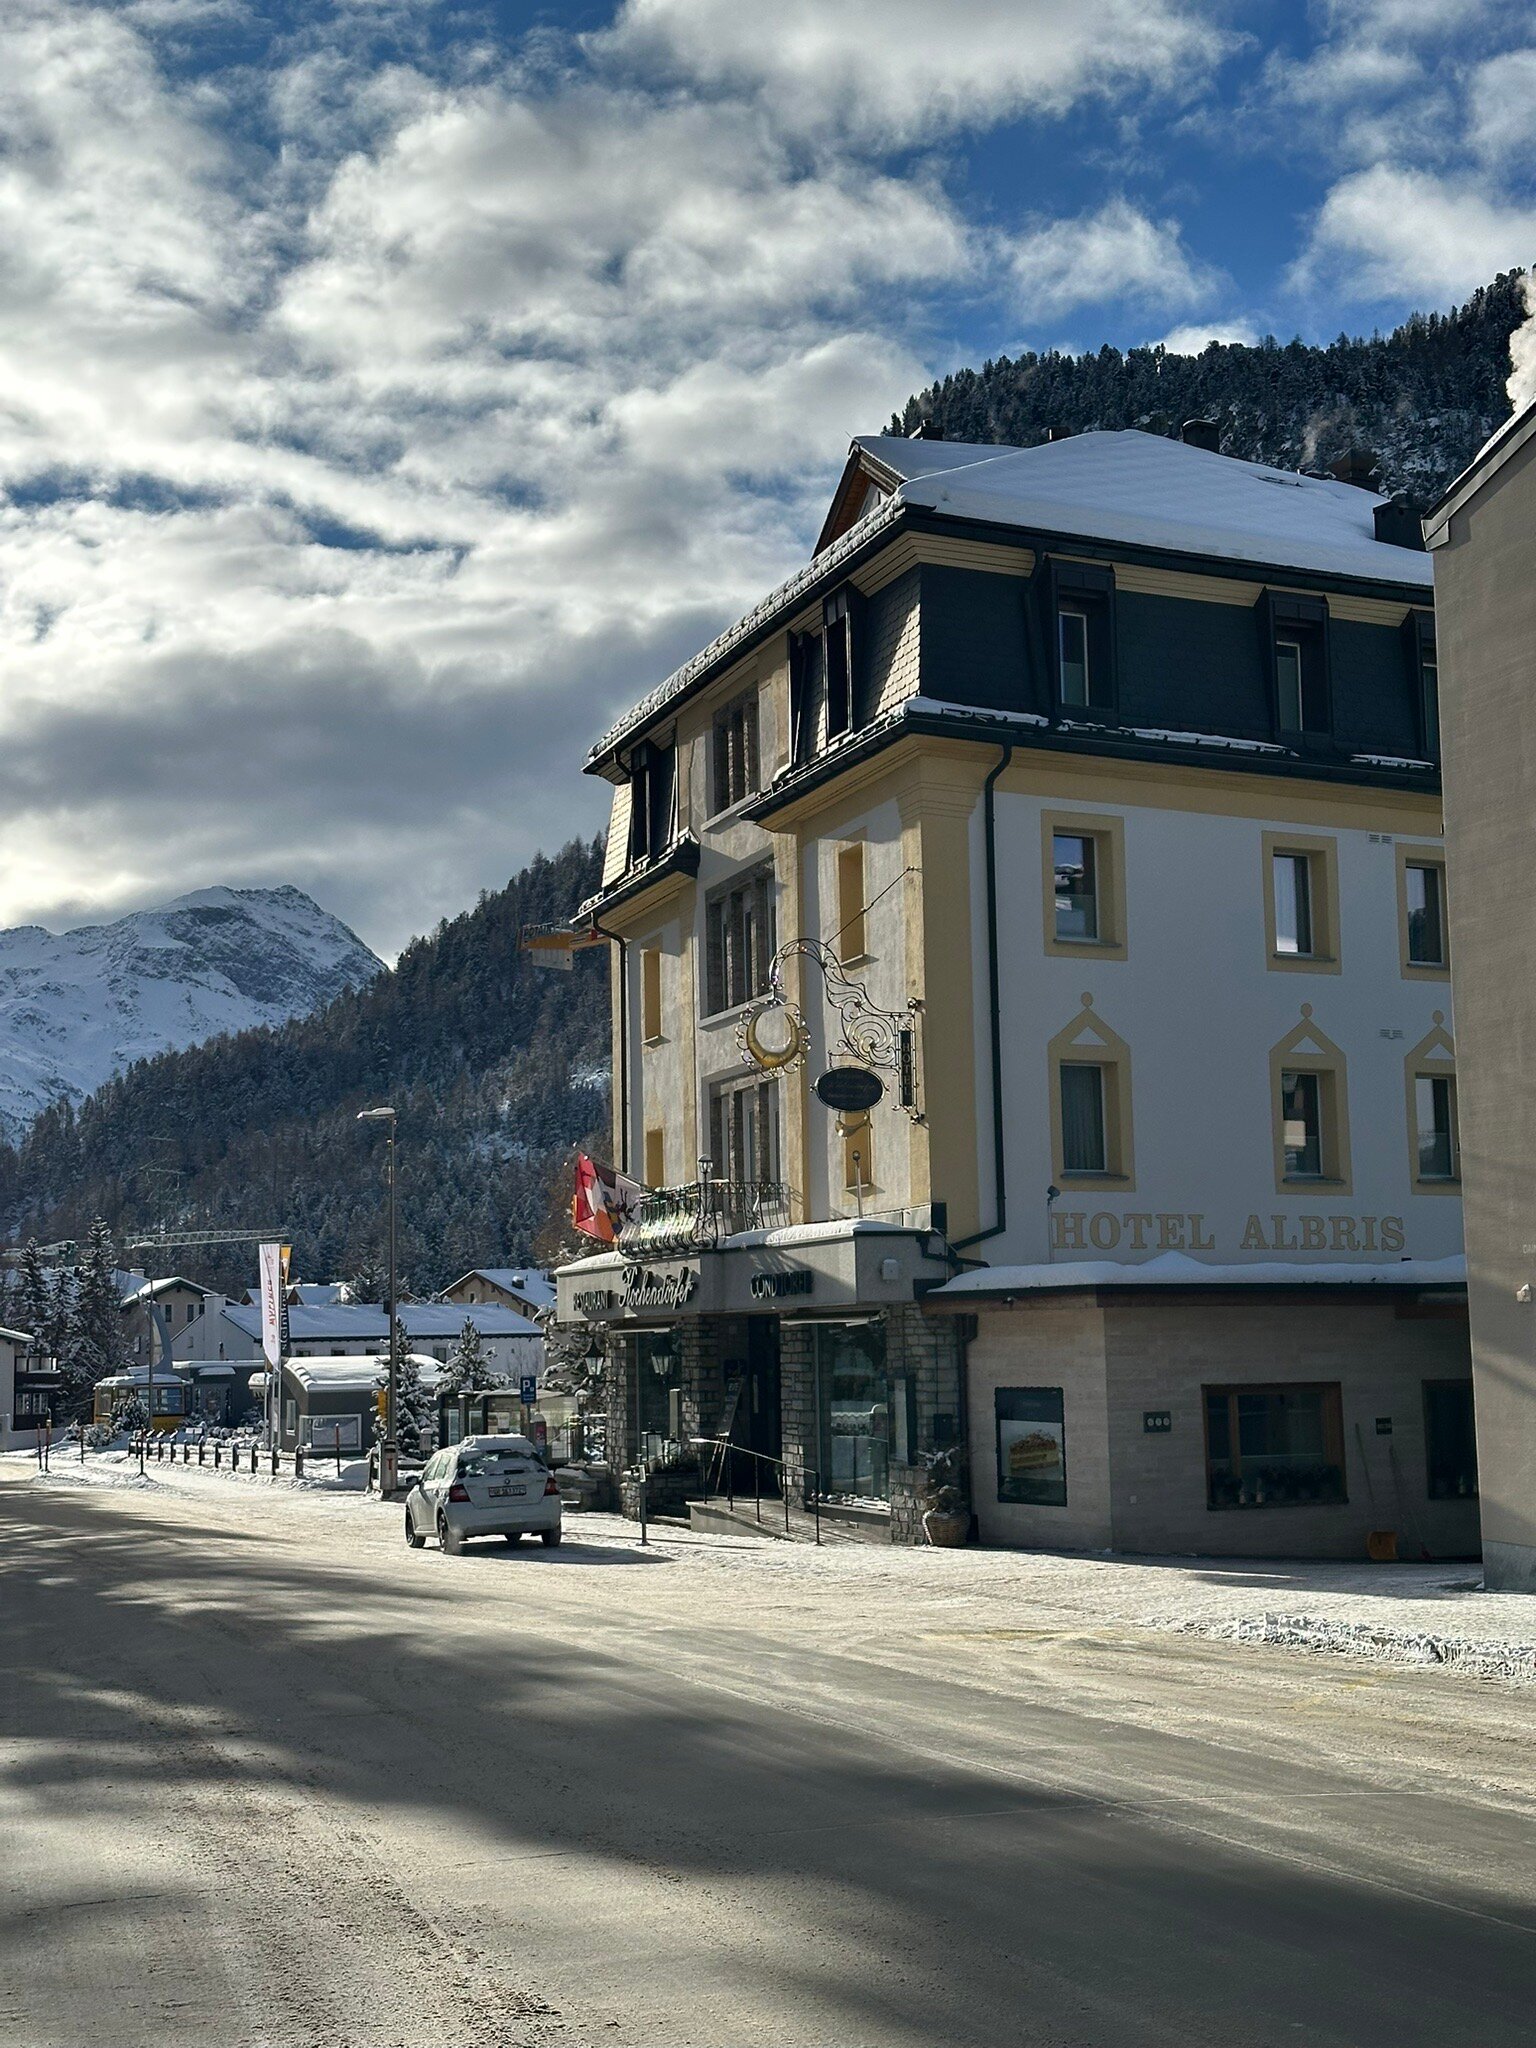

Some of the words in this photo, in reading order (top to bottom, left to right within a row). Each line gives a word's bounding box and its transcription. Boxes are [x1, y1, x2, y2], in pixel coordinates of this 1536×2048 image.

[902, 1042, 911, 1097] HOTEL
[1052, 1212, 1215, 1250] HOTEL
[1240, 1214, 1405, 1251] ALBRIS
